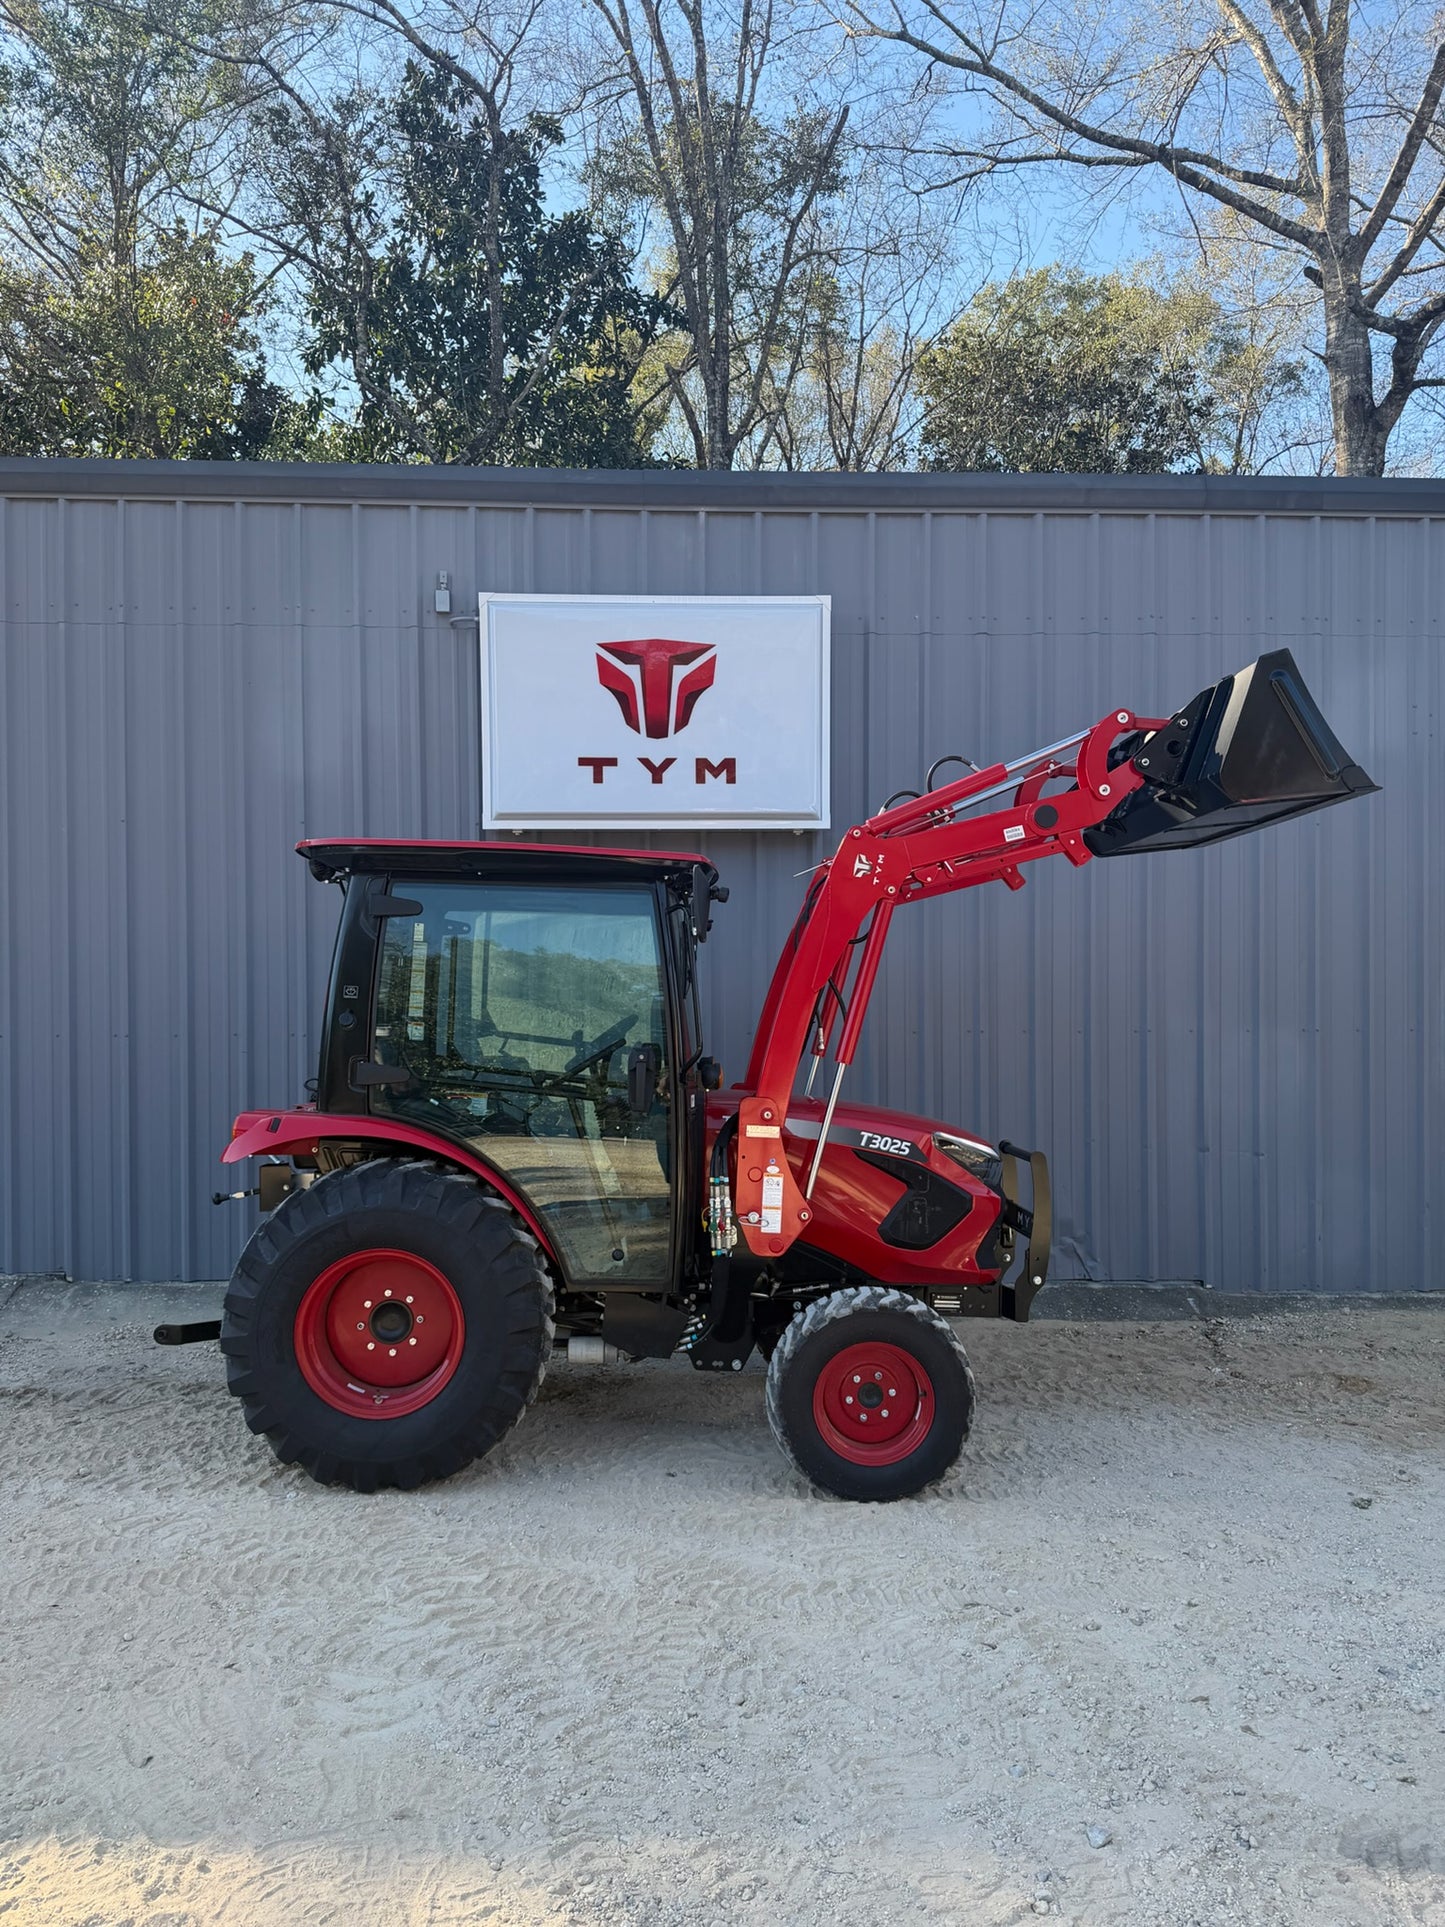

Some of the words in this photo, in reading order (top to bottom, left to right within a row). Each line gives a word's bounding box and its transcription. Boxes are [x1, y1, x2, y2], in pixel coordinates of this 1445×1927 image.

[577, 757, 737, 784] TYM
[872, 854, 885, 886] TYM
[860, 1131, 912, 1156] T3025
